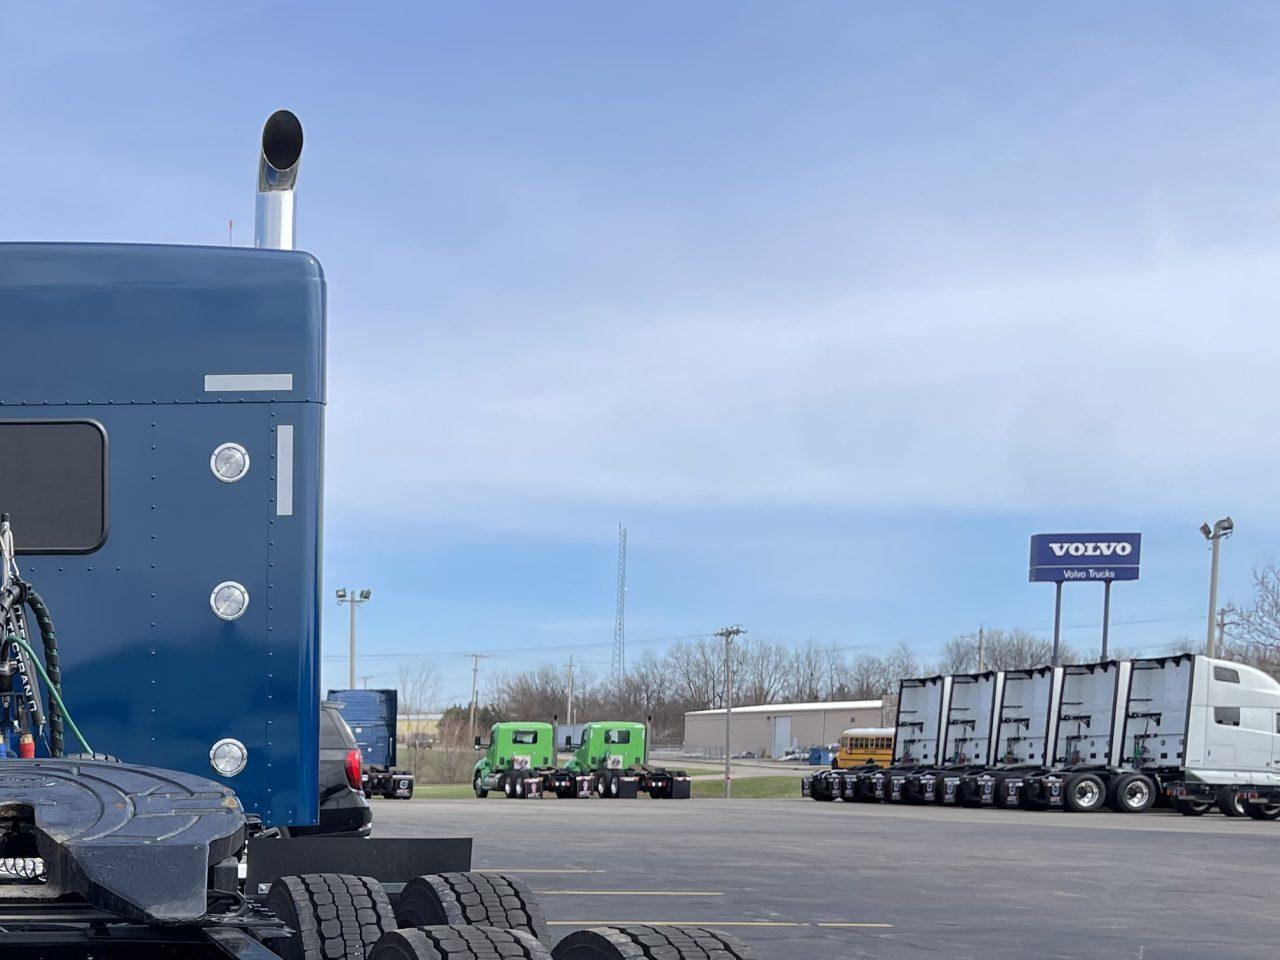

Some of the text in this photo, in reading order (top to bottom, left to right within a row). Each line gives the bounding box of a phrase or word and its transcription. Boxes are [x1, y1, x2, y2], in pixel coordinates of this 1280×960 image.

[1049, 542, 1132, 556] VOLVO
[1063, 569, 1115, 579] Volvo Trucks
